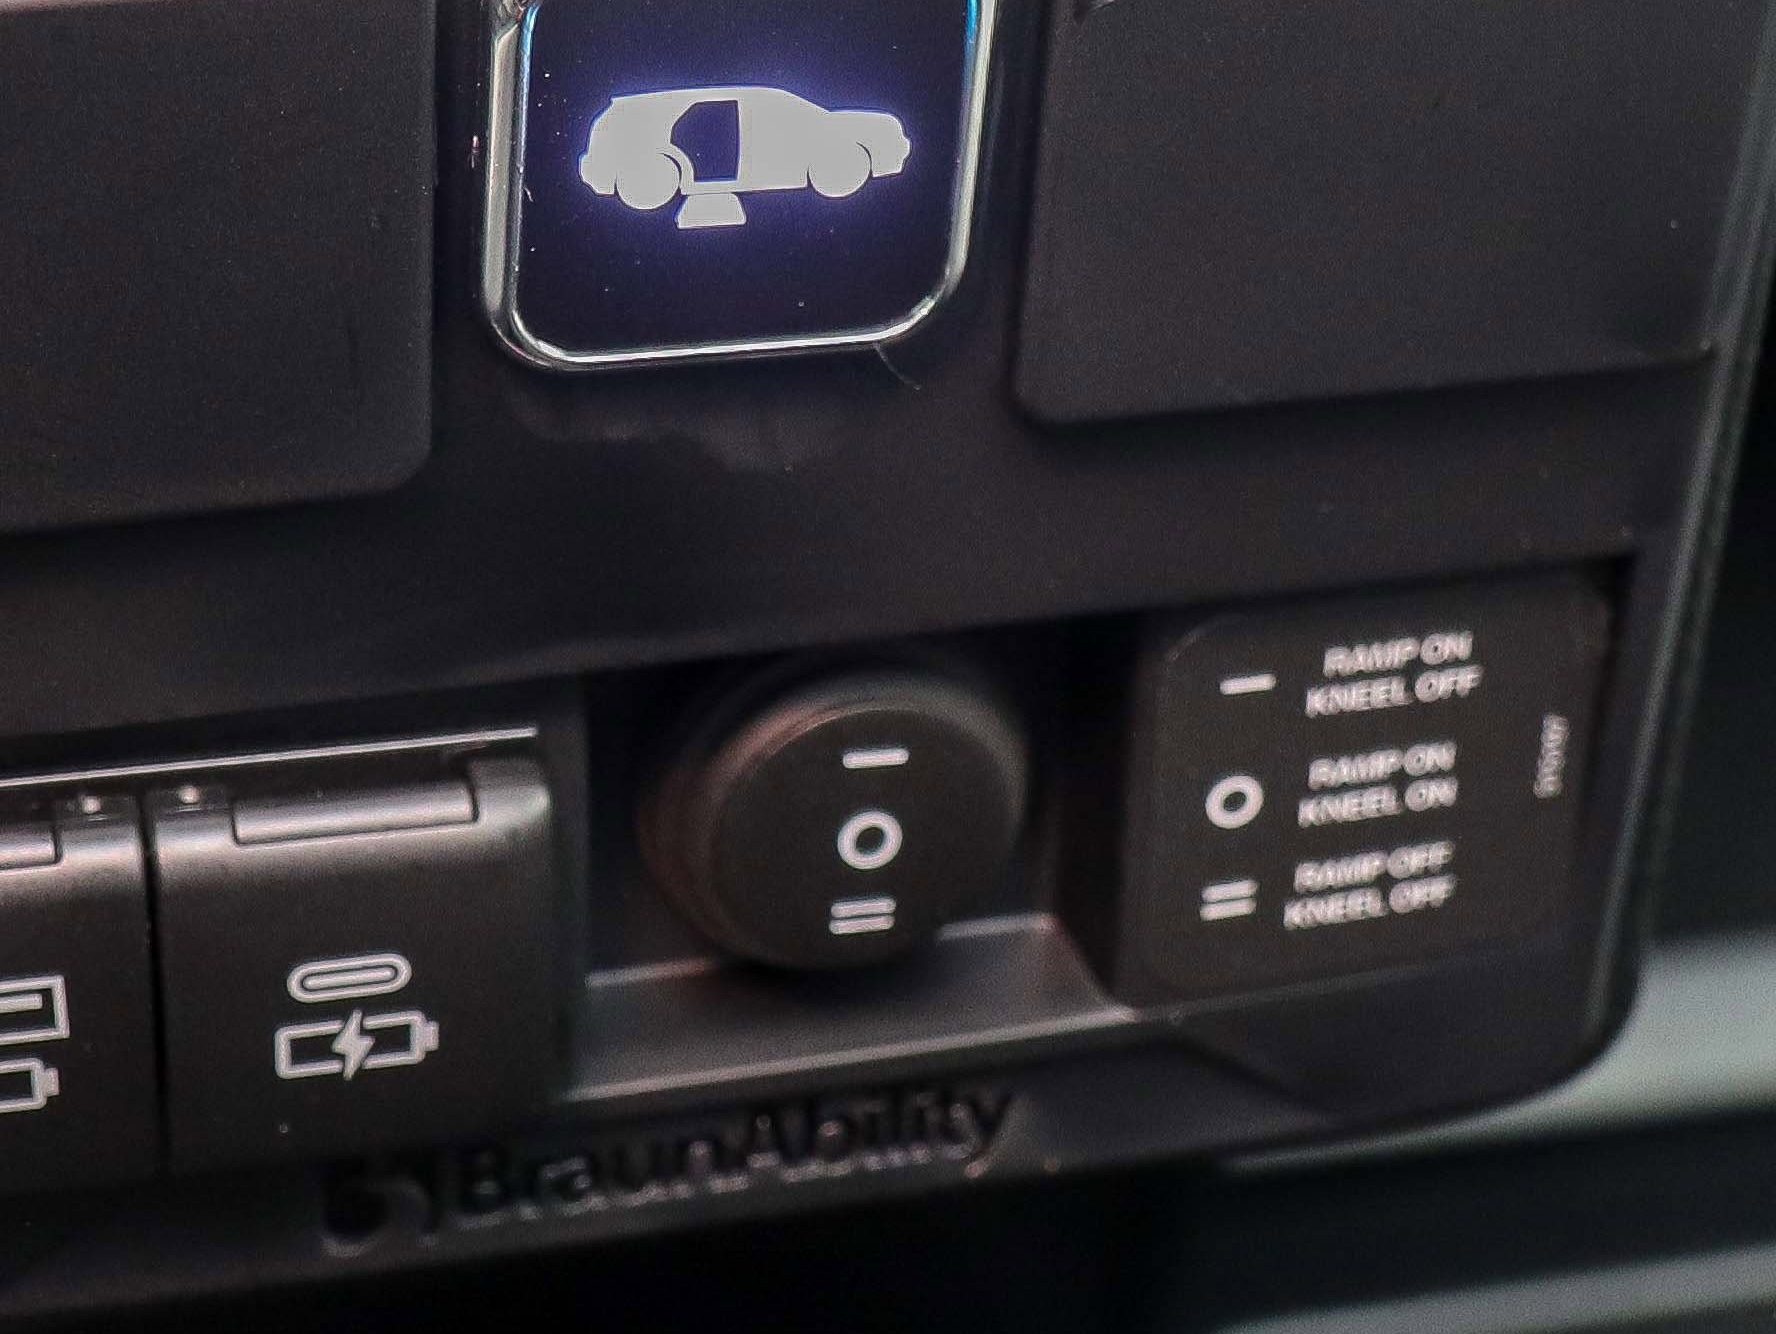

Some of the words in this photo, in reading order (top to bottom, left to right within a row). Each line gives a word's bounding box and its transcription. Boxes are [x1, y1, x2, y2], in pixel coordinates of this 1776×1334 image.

[1421, 630, 1474, 666] ON
[1306, 676, 1413, 719] KNEEL
[1414, 665, 1485, 704] OFF
[1403, 740, 1458, 776] ON
[1297, 785, 1402, 827] KNEEL
[1404, 776, 1459, 812] ON
[1386, 840, 1456, 880] OFF
[1282, 886, 1386, 931] KNEEL
[1388, 874, 1458, 915] OFF
[454, 1081, 1014, 1232] BraunAbility
